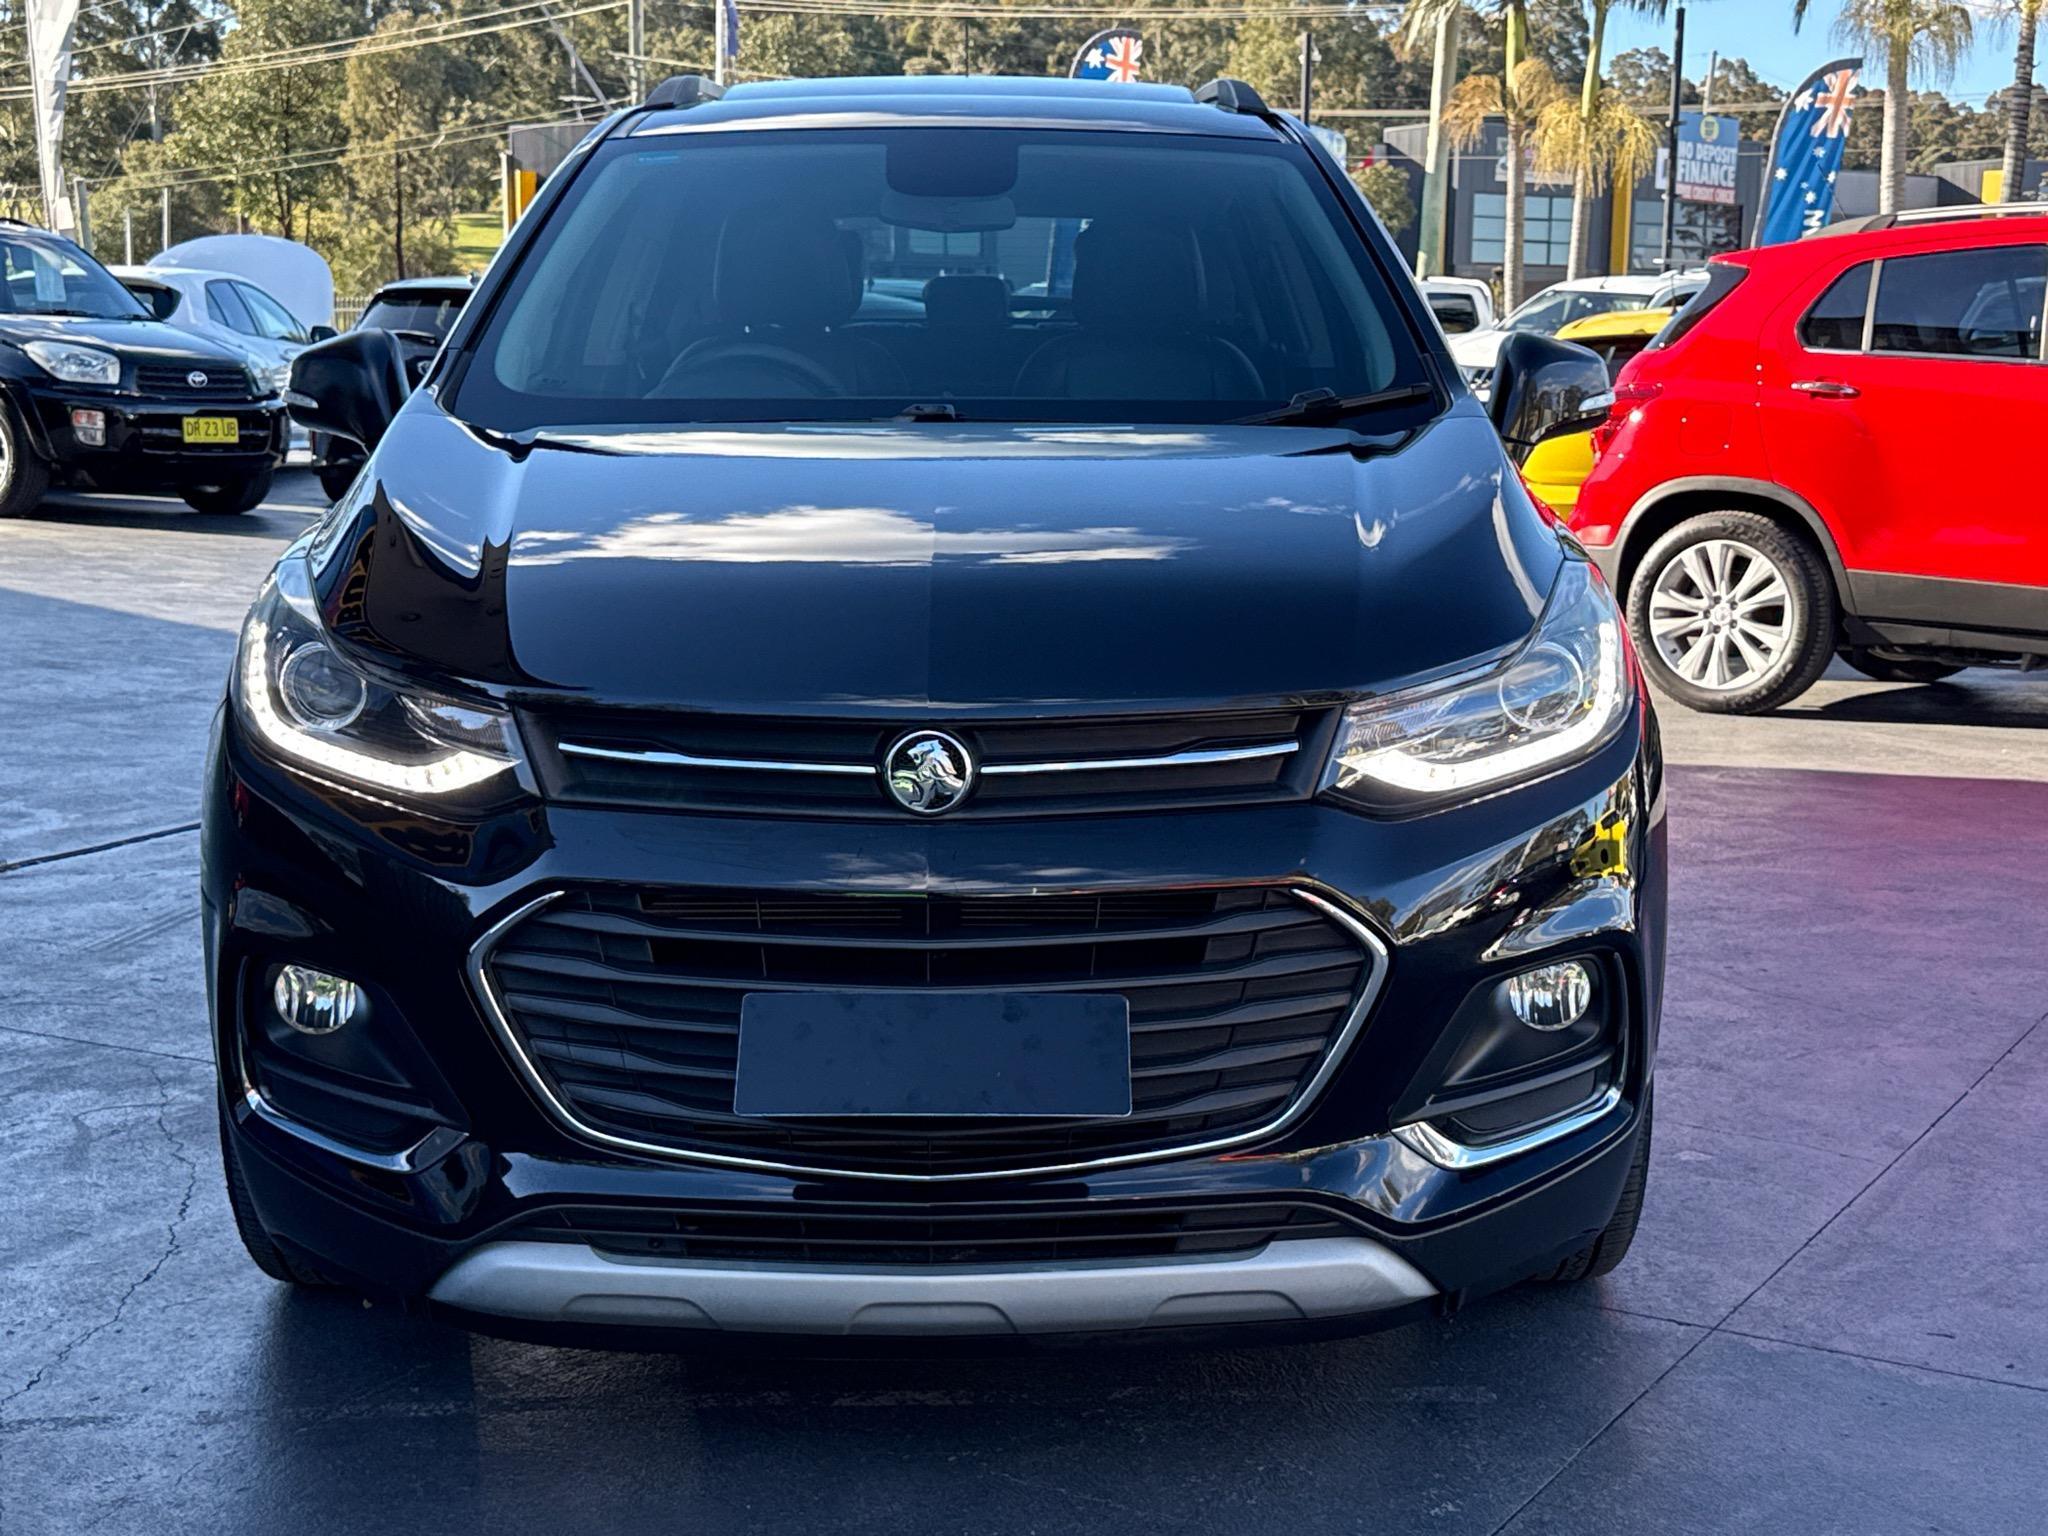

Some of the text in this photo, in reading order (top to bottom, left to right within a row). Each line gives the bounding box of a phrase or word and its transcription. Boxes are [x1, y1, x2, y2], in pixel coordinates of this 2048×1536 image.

[1695, 143, 1737, 165] DEPOSIT
[1677, 160, 1735, 188] FINANCE
[204, 421, 219, 437] 23
